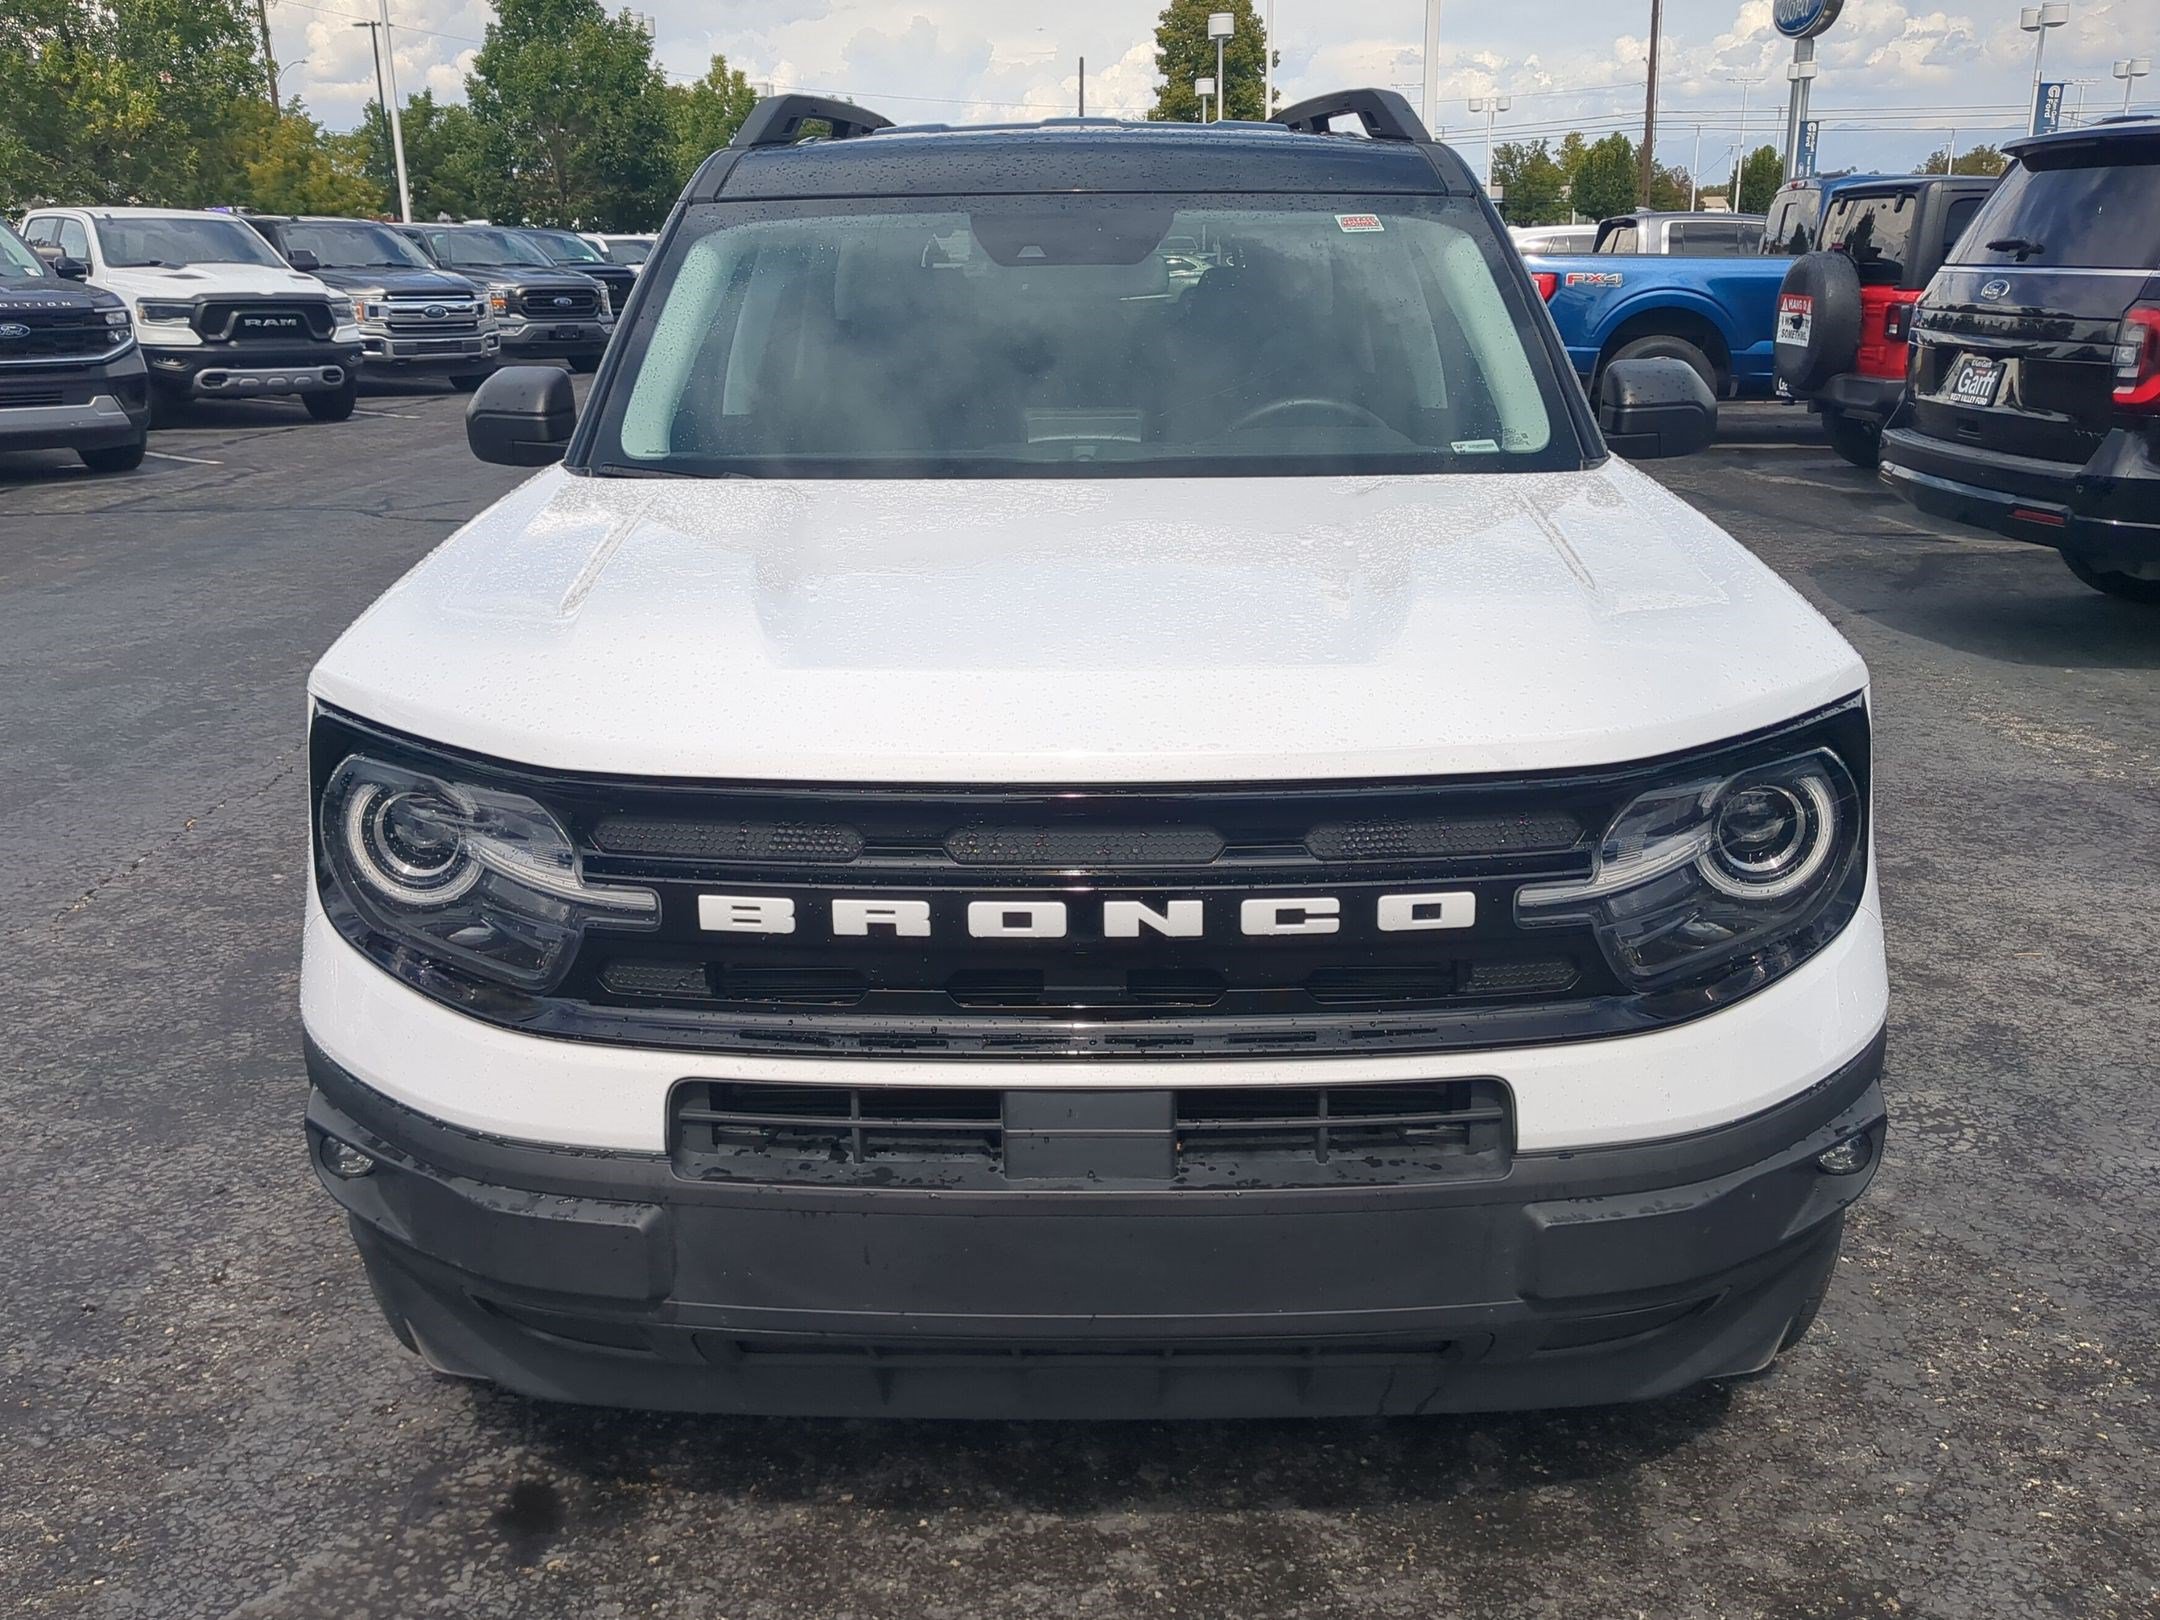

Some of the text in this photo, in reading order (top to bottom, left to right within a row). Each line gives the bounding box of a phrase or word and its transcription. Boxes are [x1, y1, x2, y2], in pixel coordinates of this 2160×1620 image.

[2044, 98, 2053, 118] Ford
[1565, 272, 1622, 287] FX4
[1957, 367, 1998, 396] Garff
[698, 891, 1477, 938] BRONCO
